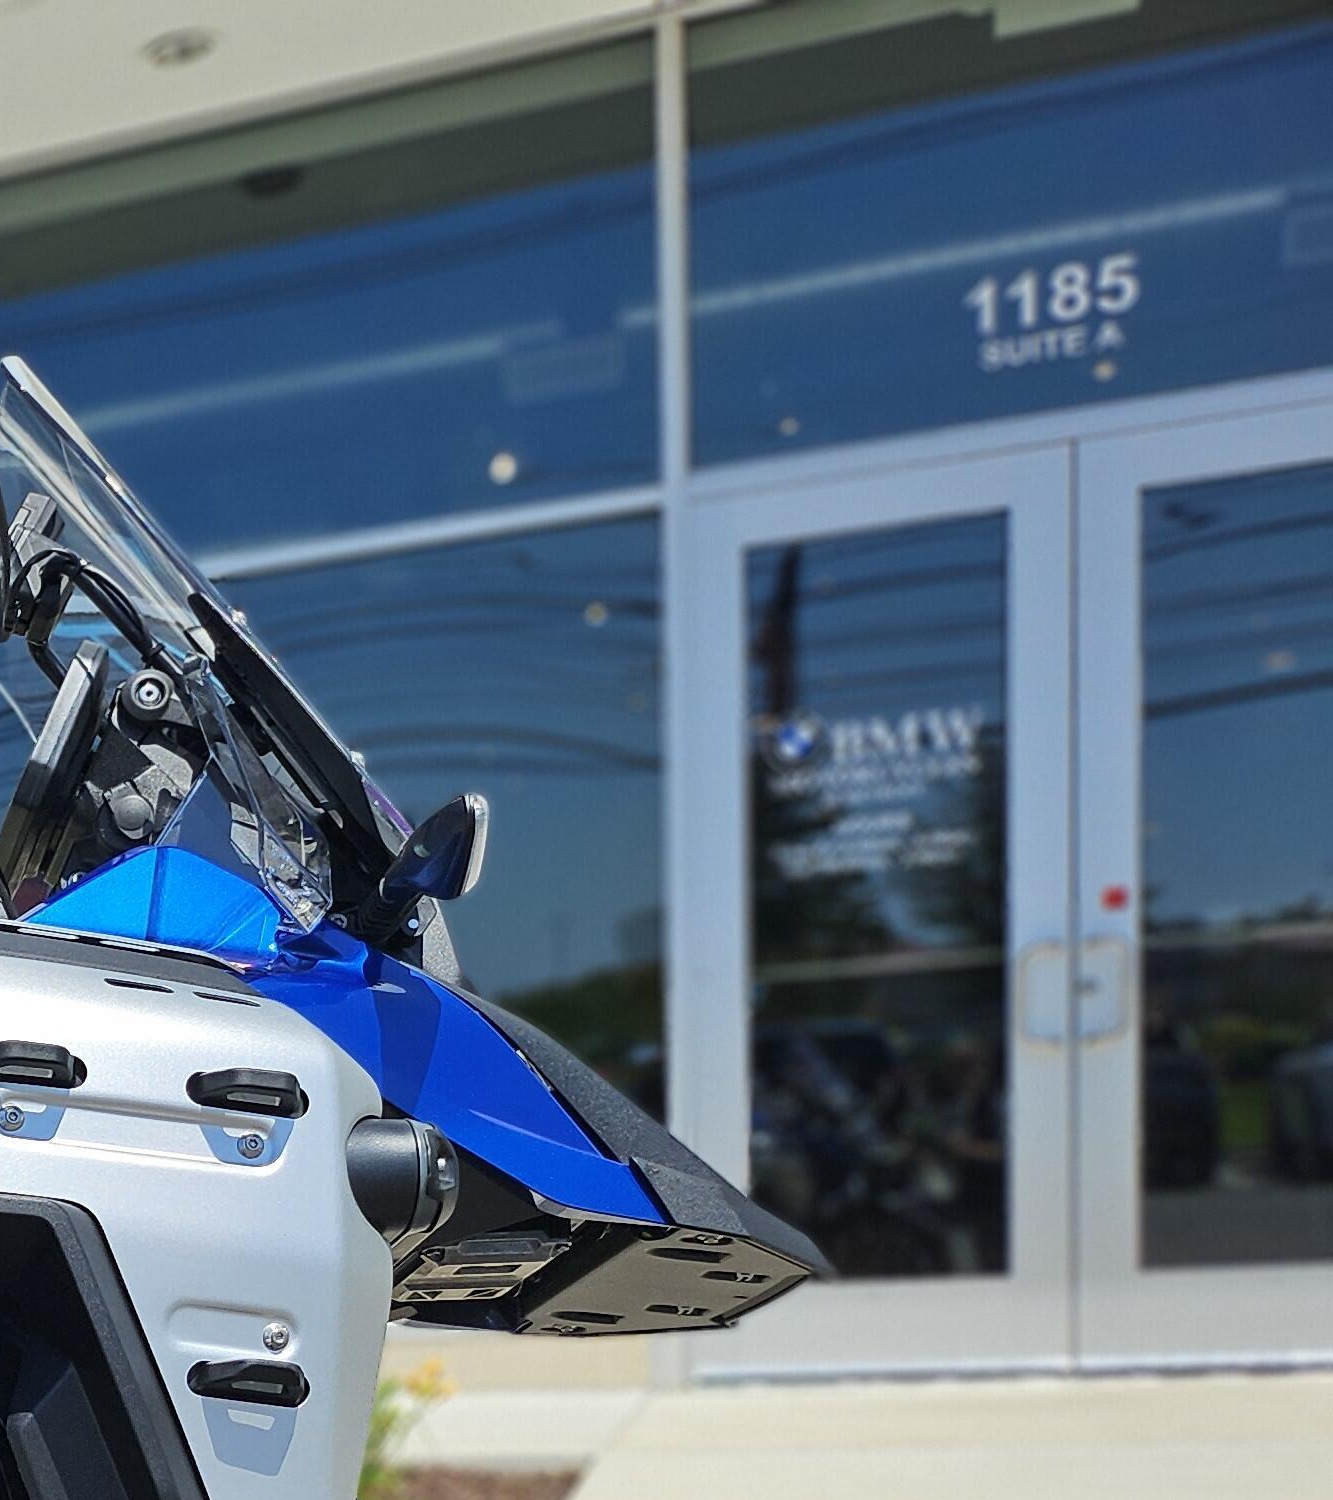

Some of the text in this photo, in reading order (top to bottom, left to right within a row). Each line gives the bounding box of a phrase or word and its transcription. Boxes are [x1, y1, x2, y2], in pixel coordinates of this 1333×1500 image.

[963, 252, 1141, 336] 1185
[980, 319, 1127, 373] SUITE A
[830, 705, 984, 761] BMW
